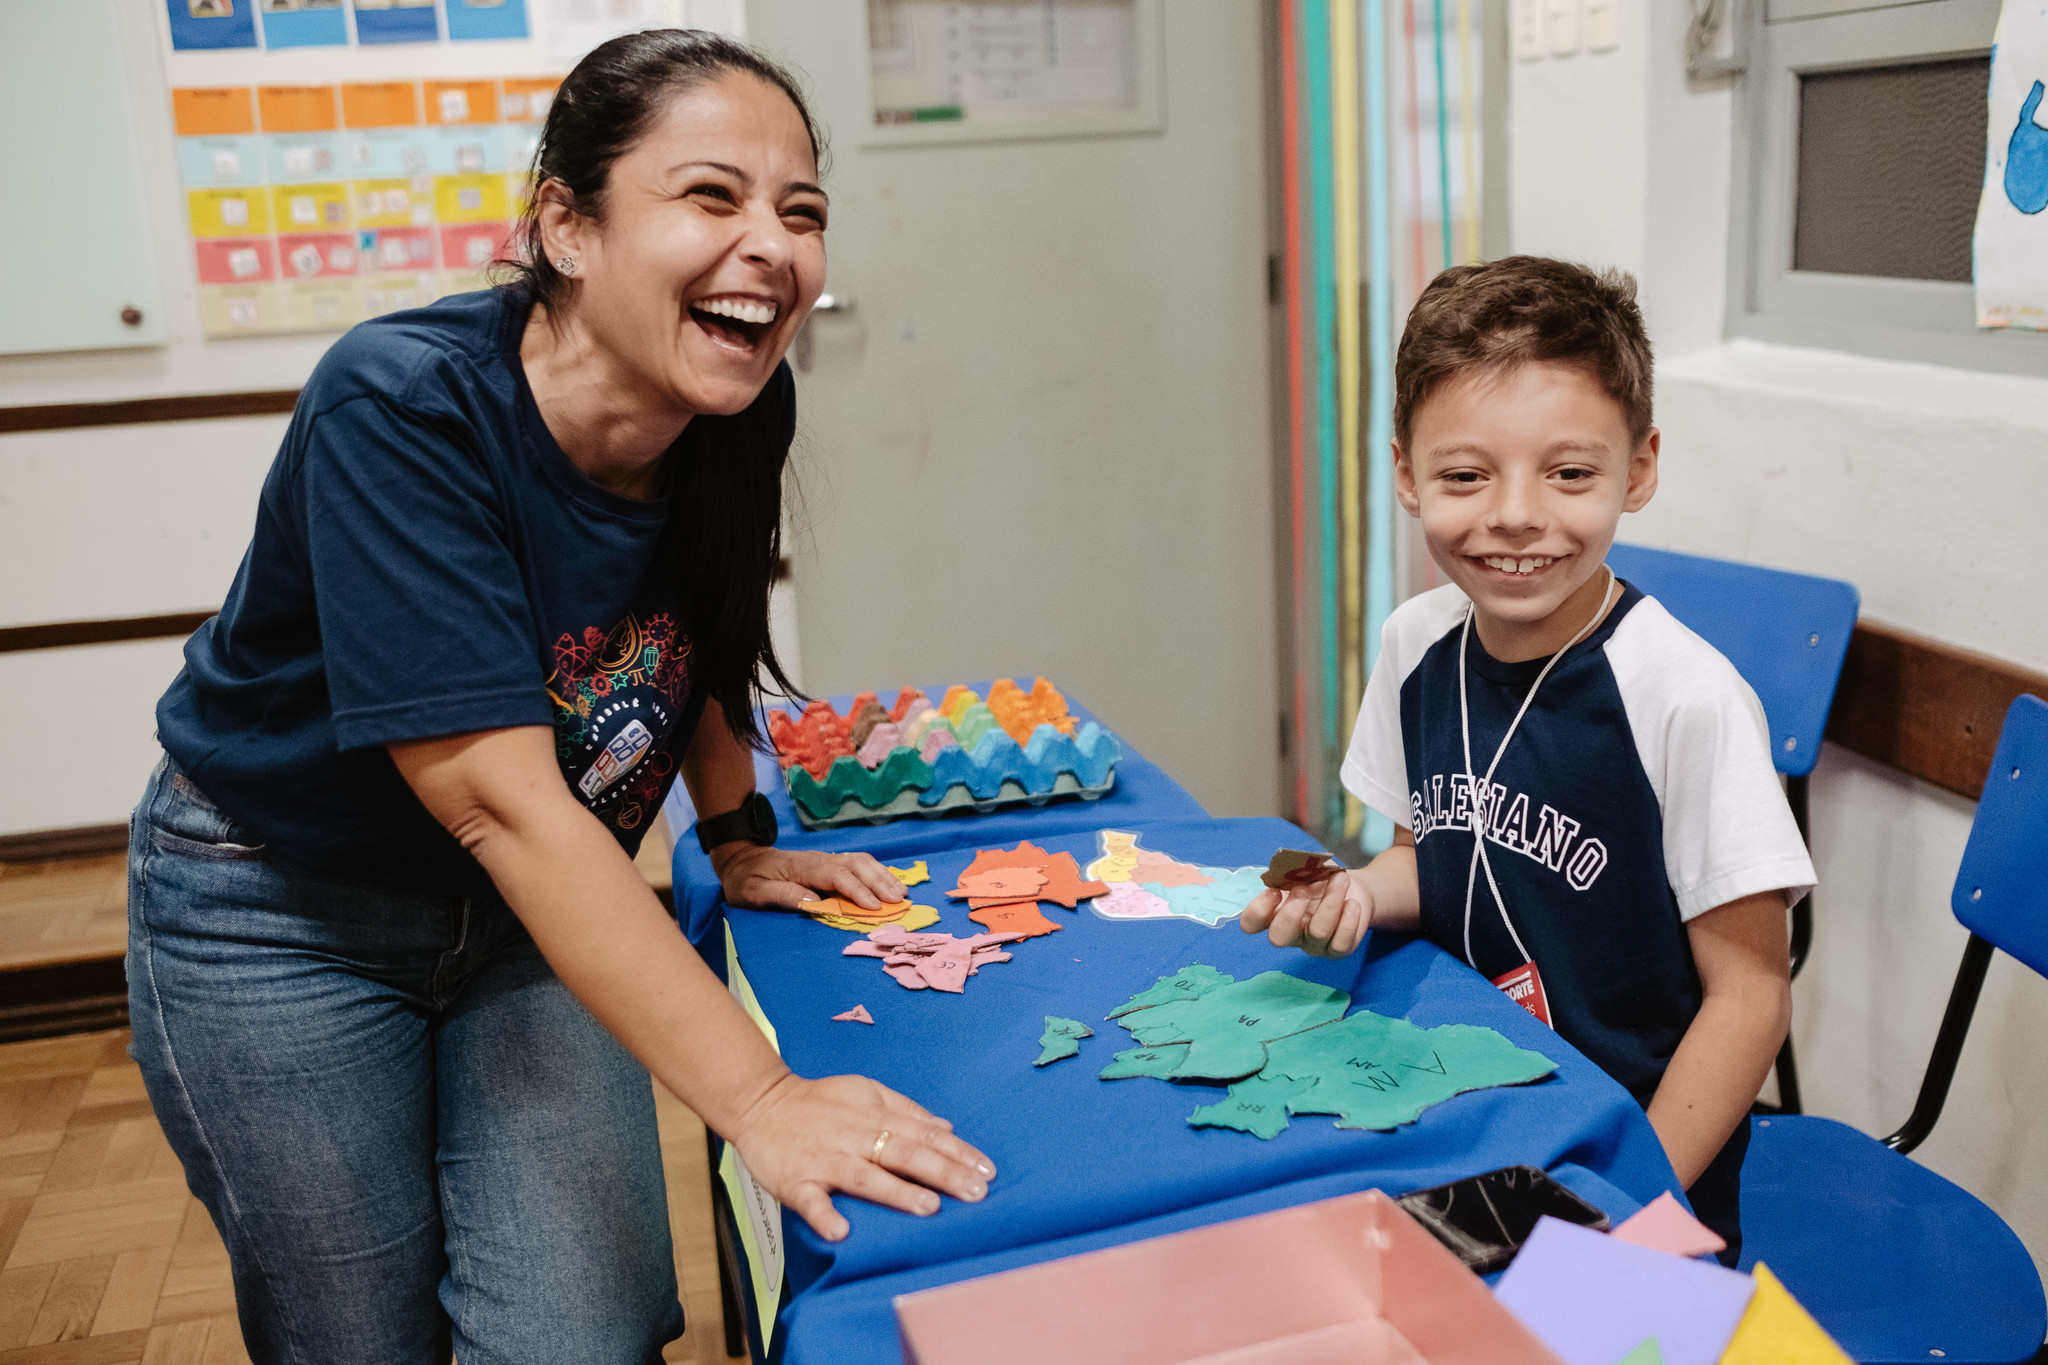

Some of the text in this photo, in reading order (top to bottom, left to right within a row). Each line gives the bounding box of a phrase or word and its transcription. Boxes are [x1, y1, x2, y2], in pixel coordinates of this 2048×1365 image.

[1411, 774, 1608, 891] SALESIANO
[1173, 979, 1195, 992] TO
[1237, 1014, 1260, 1028] PA
[1345, 1056, 1381, 1070] AM
[1236, 1102, 1265, 1114] RR
